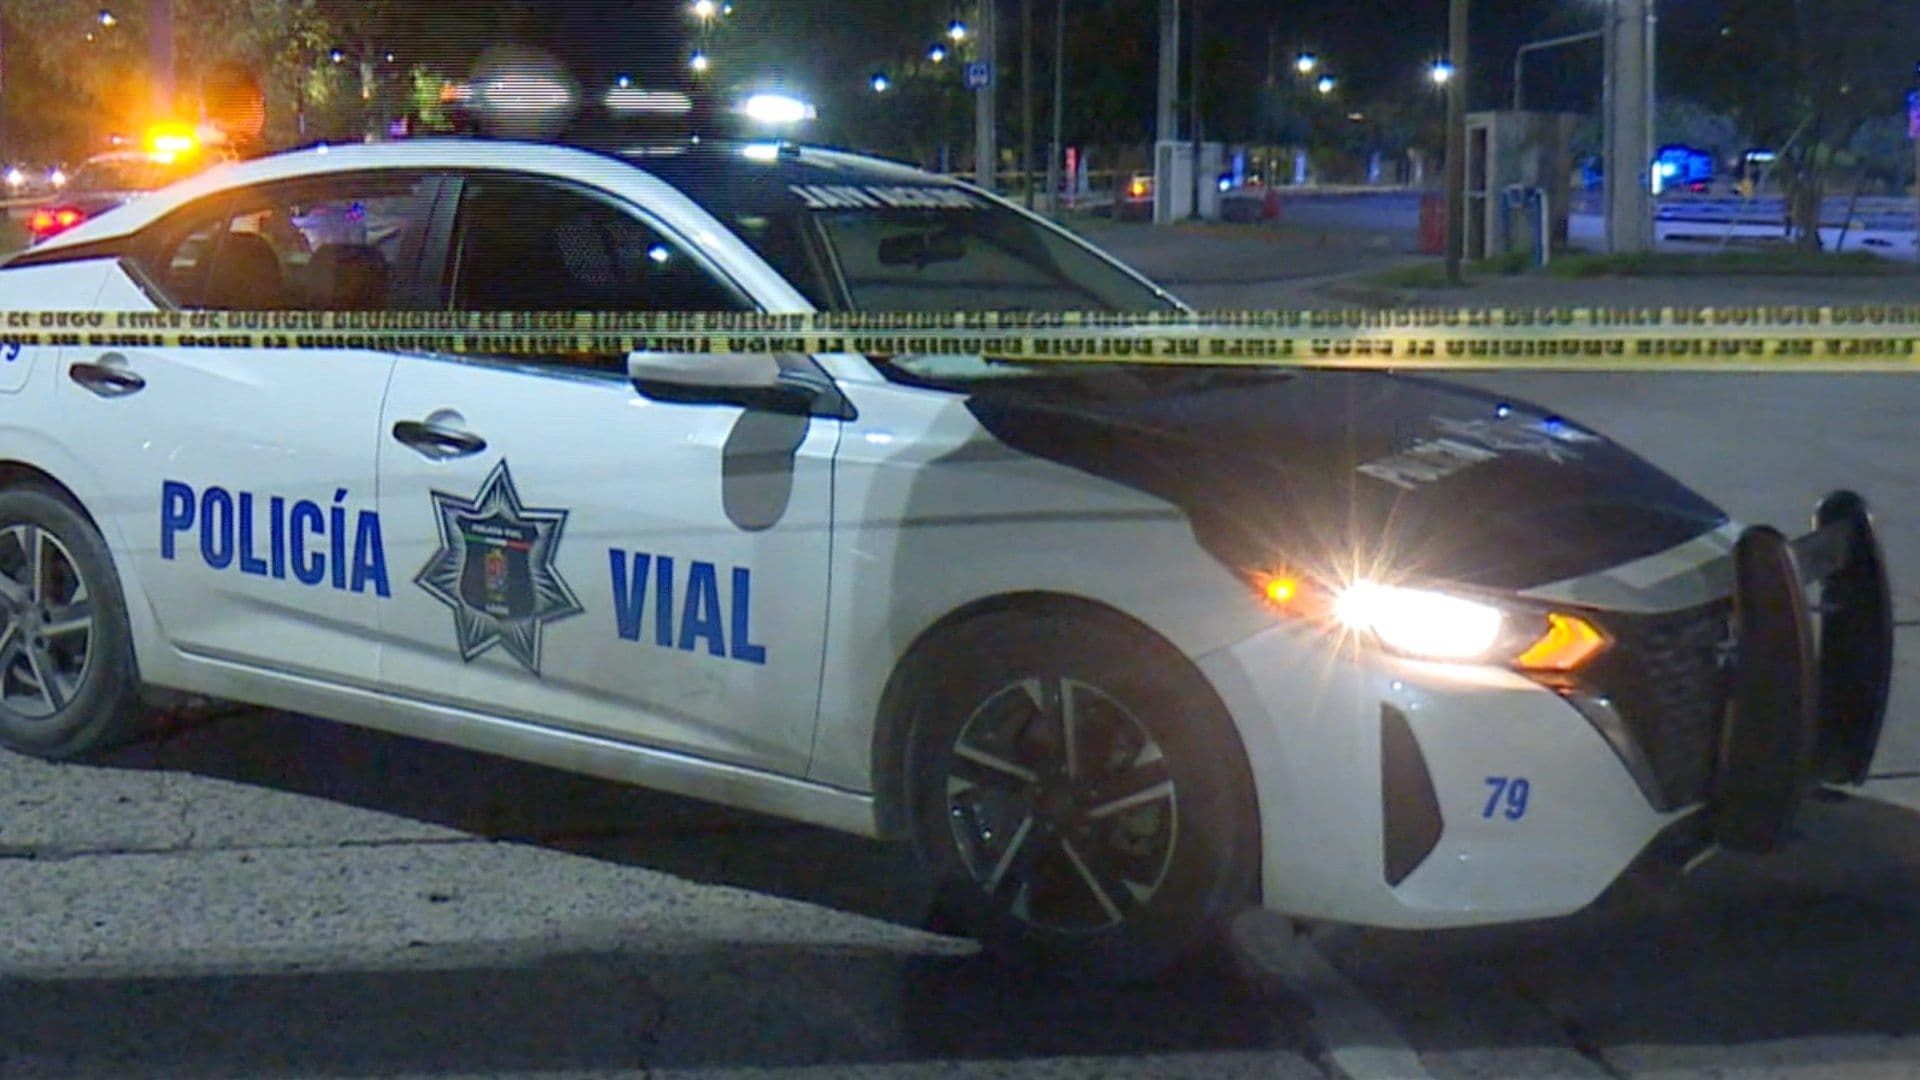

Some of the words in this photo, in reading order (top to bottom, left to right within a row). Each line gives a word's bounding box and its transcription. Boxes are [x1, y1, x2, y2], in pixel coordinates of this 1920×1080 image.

[160, 479, 392, 598] POLICÍA
[608, 547, 768, 665] VIAL
[1482, 776, 1530, 820] 79
